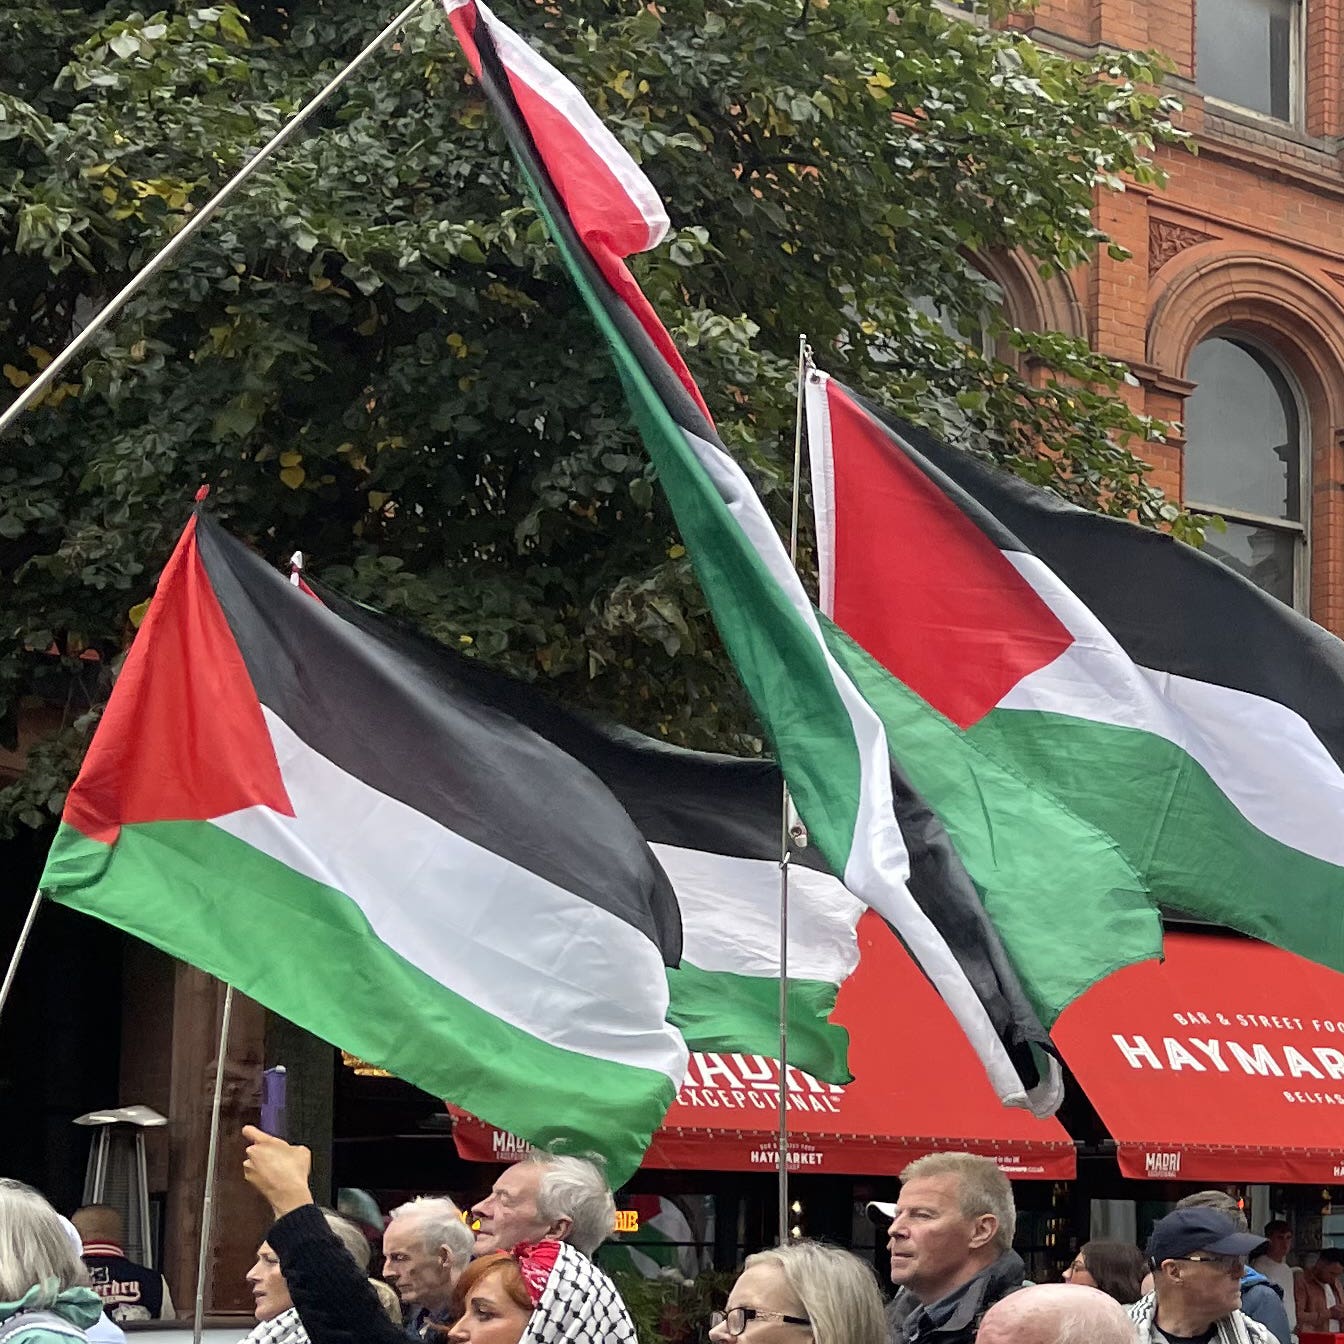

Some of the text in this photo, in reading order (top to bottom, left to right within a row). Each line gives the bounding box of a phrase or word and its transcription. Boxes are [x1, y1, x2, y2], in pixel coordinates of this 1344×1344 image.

[1173, 1011, 1211, 1026] BAR
[1216, 1013, 1231, 1026] &
[1235, 1014, 1304, 1031] STREET
